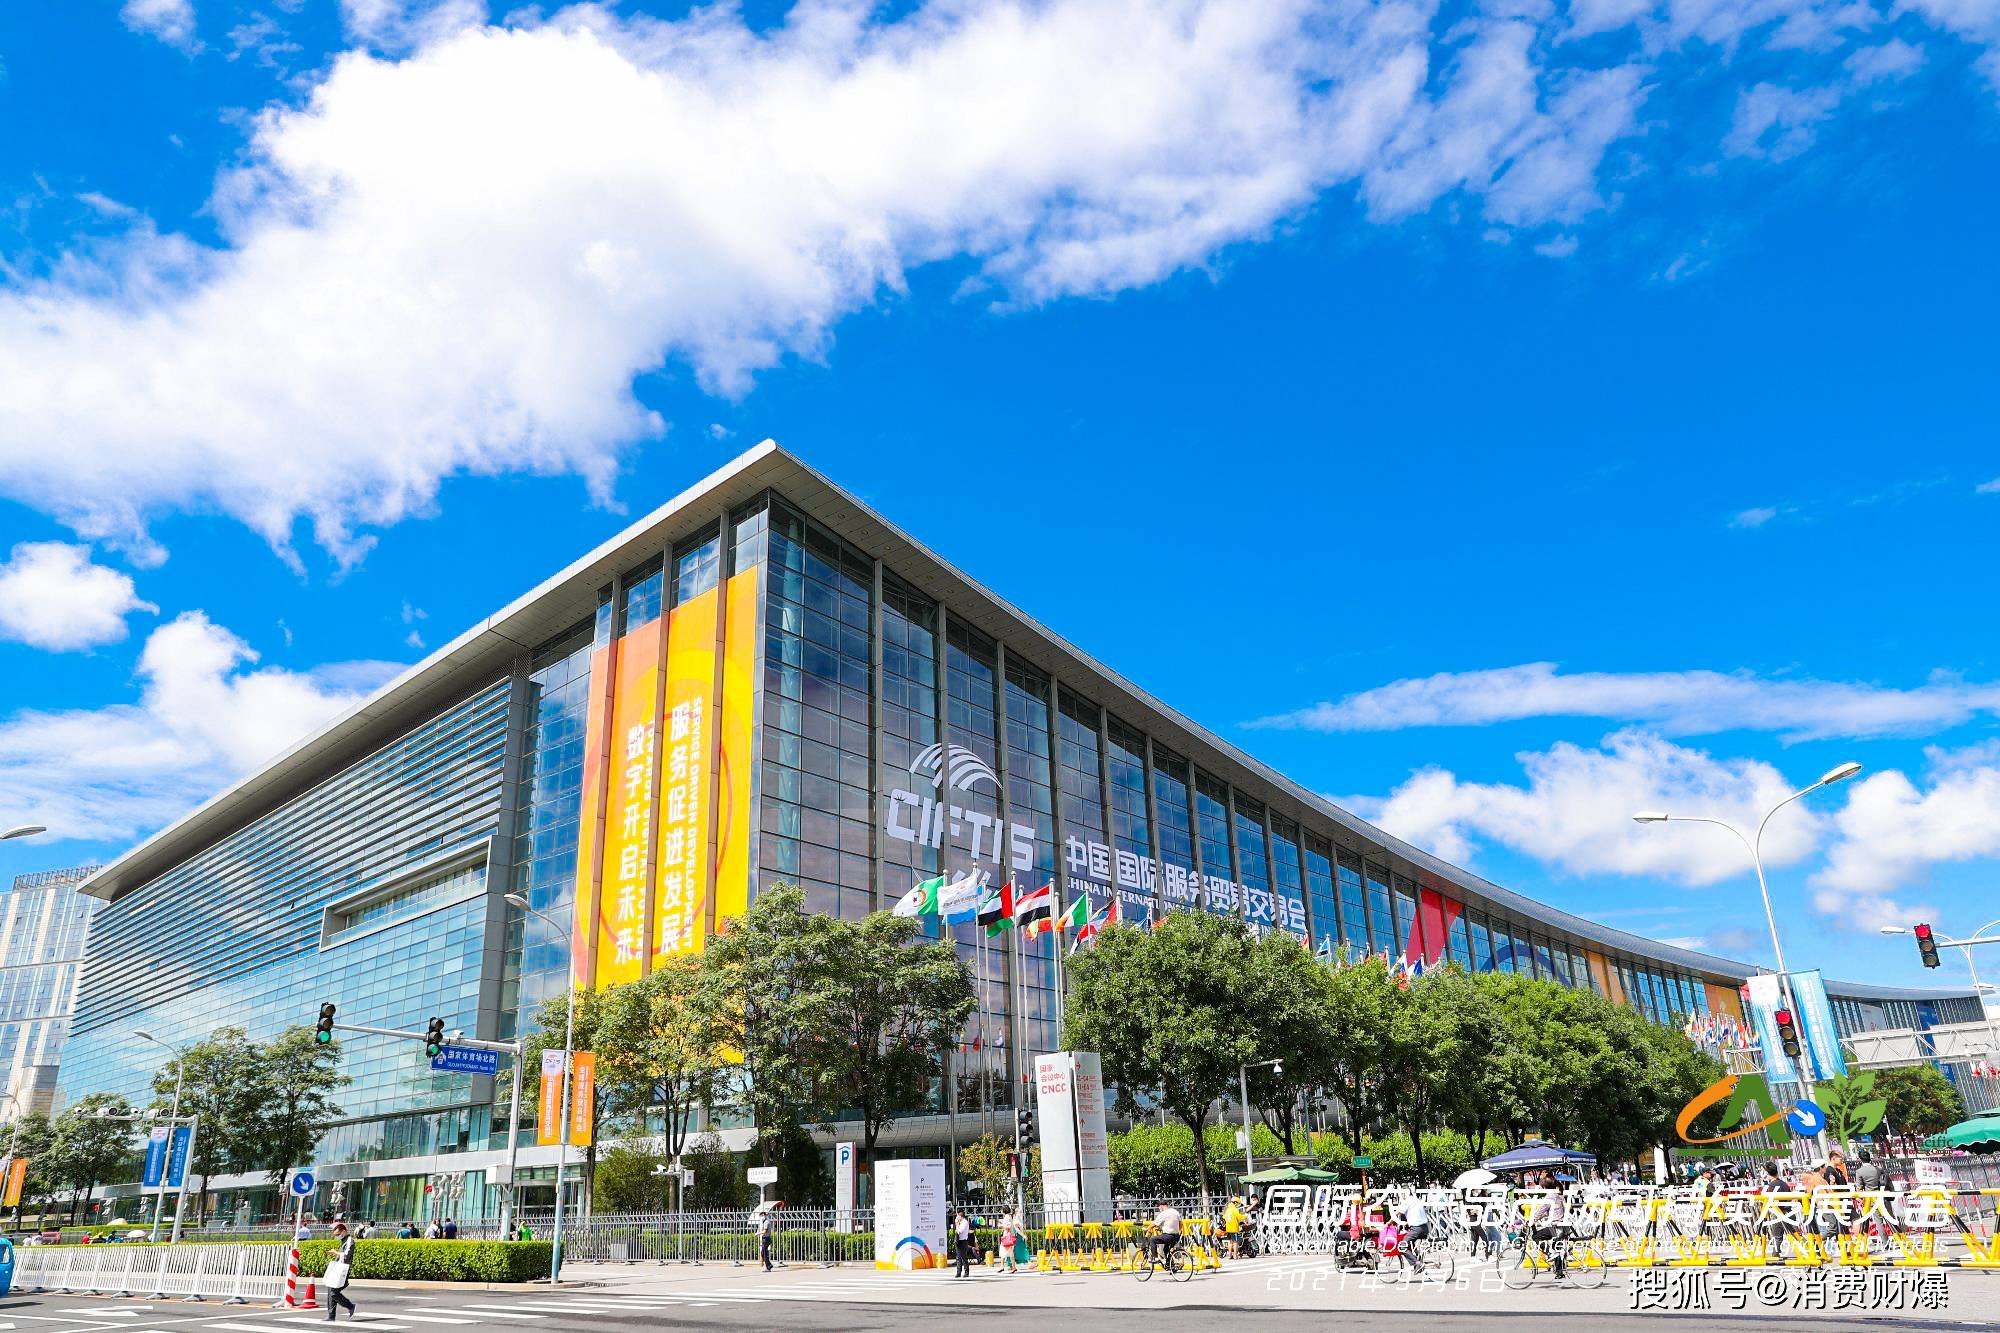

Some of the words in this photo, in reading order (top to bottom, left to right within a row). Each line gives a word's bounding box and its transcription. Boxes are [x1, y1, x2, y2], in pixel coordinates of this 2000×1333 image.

[690, 696, 702, 760] SERVICE
[688, 764, 698, 824] DRIVEN
[614, 723, 646, 965] 数字开启未来
[660, 701, 690, 954] 服务促进发展
[887, 788, 1035, 872] CIFTIS
[684, 828, 697, 948] DEVELOPMENT
[1065, 835, 1306, 929] 中国国际服务贸易交易会
[1067, 876, 1100, 895] HINA
[1040, 1064, 1053, 1073] 国家
[1040, 1072, 1066, 1083] 会议中心
[1041, 1083, 1067, 1095] CNCC
[841, 1150, 850, 1166] P
